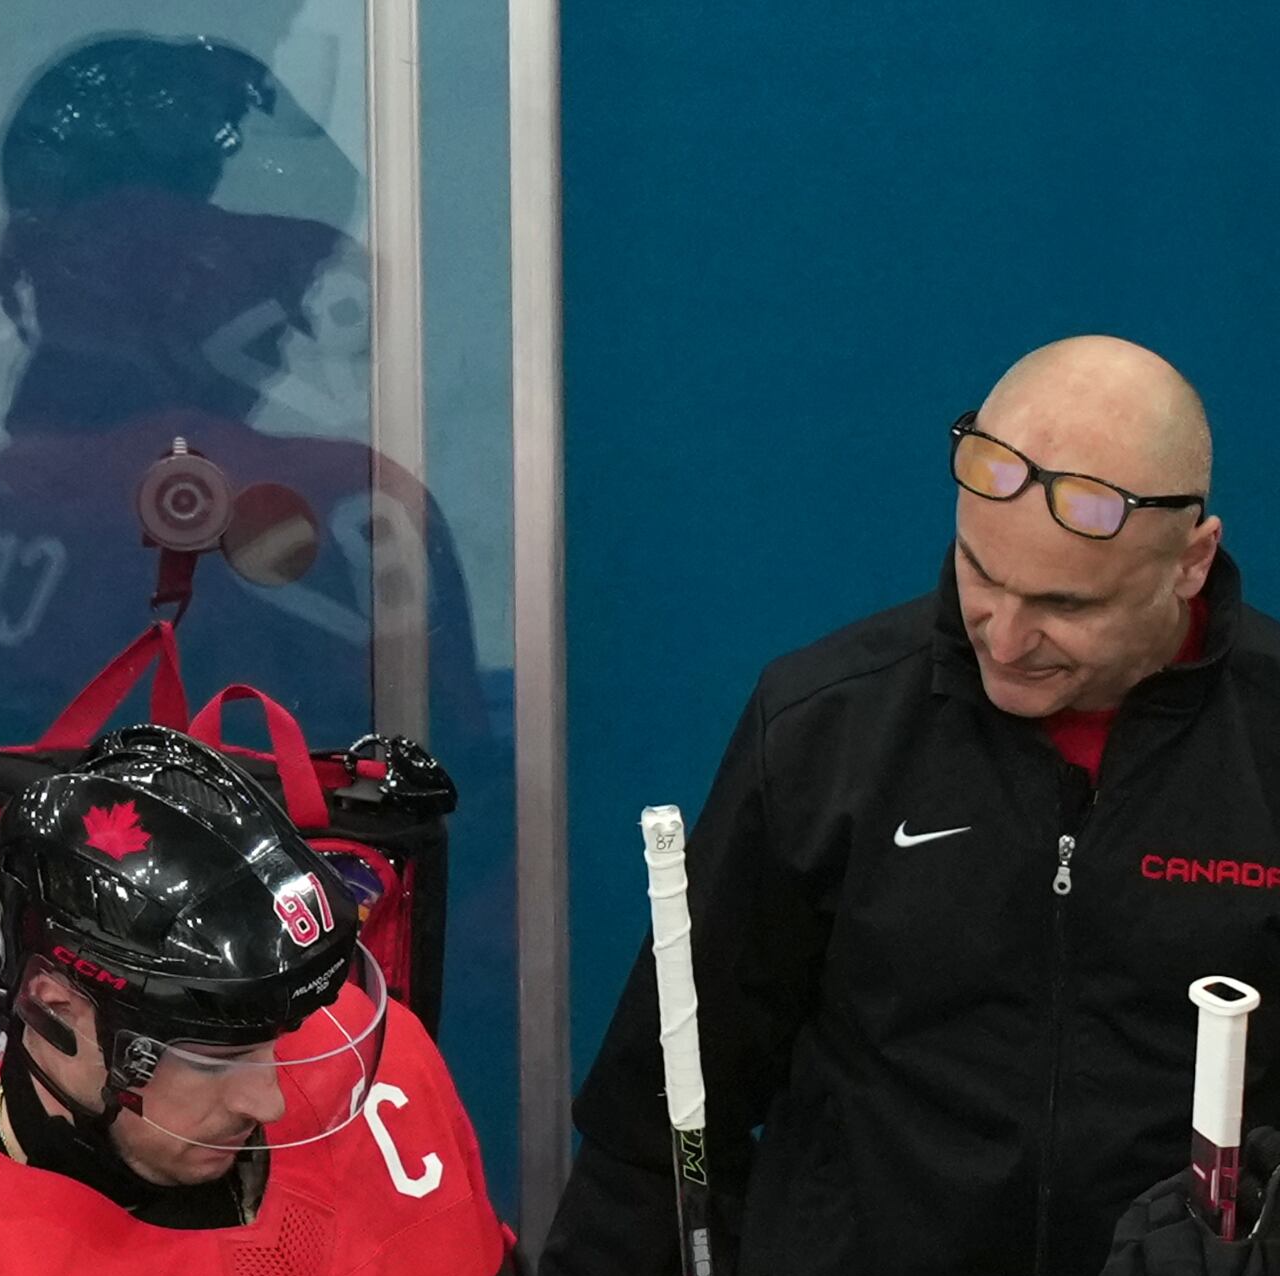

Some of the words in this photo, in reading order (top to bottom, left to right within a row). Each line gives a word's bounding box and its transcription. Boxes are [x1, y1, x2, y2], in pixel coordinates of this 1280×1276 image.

[655, 833, 676, 850] 87
[273, 871, 335, 947] 87
[52, 945, 129, 990] CCM
[361, 1079, 444, 1199] C
